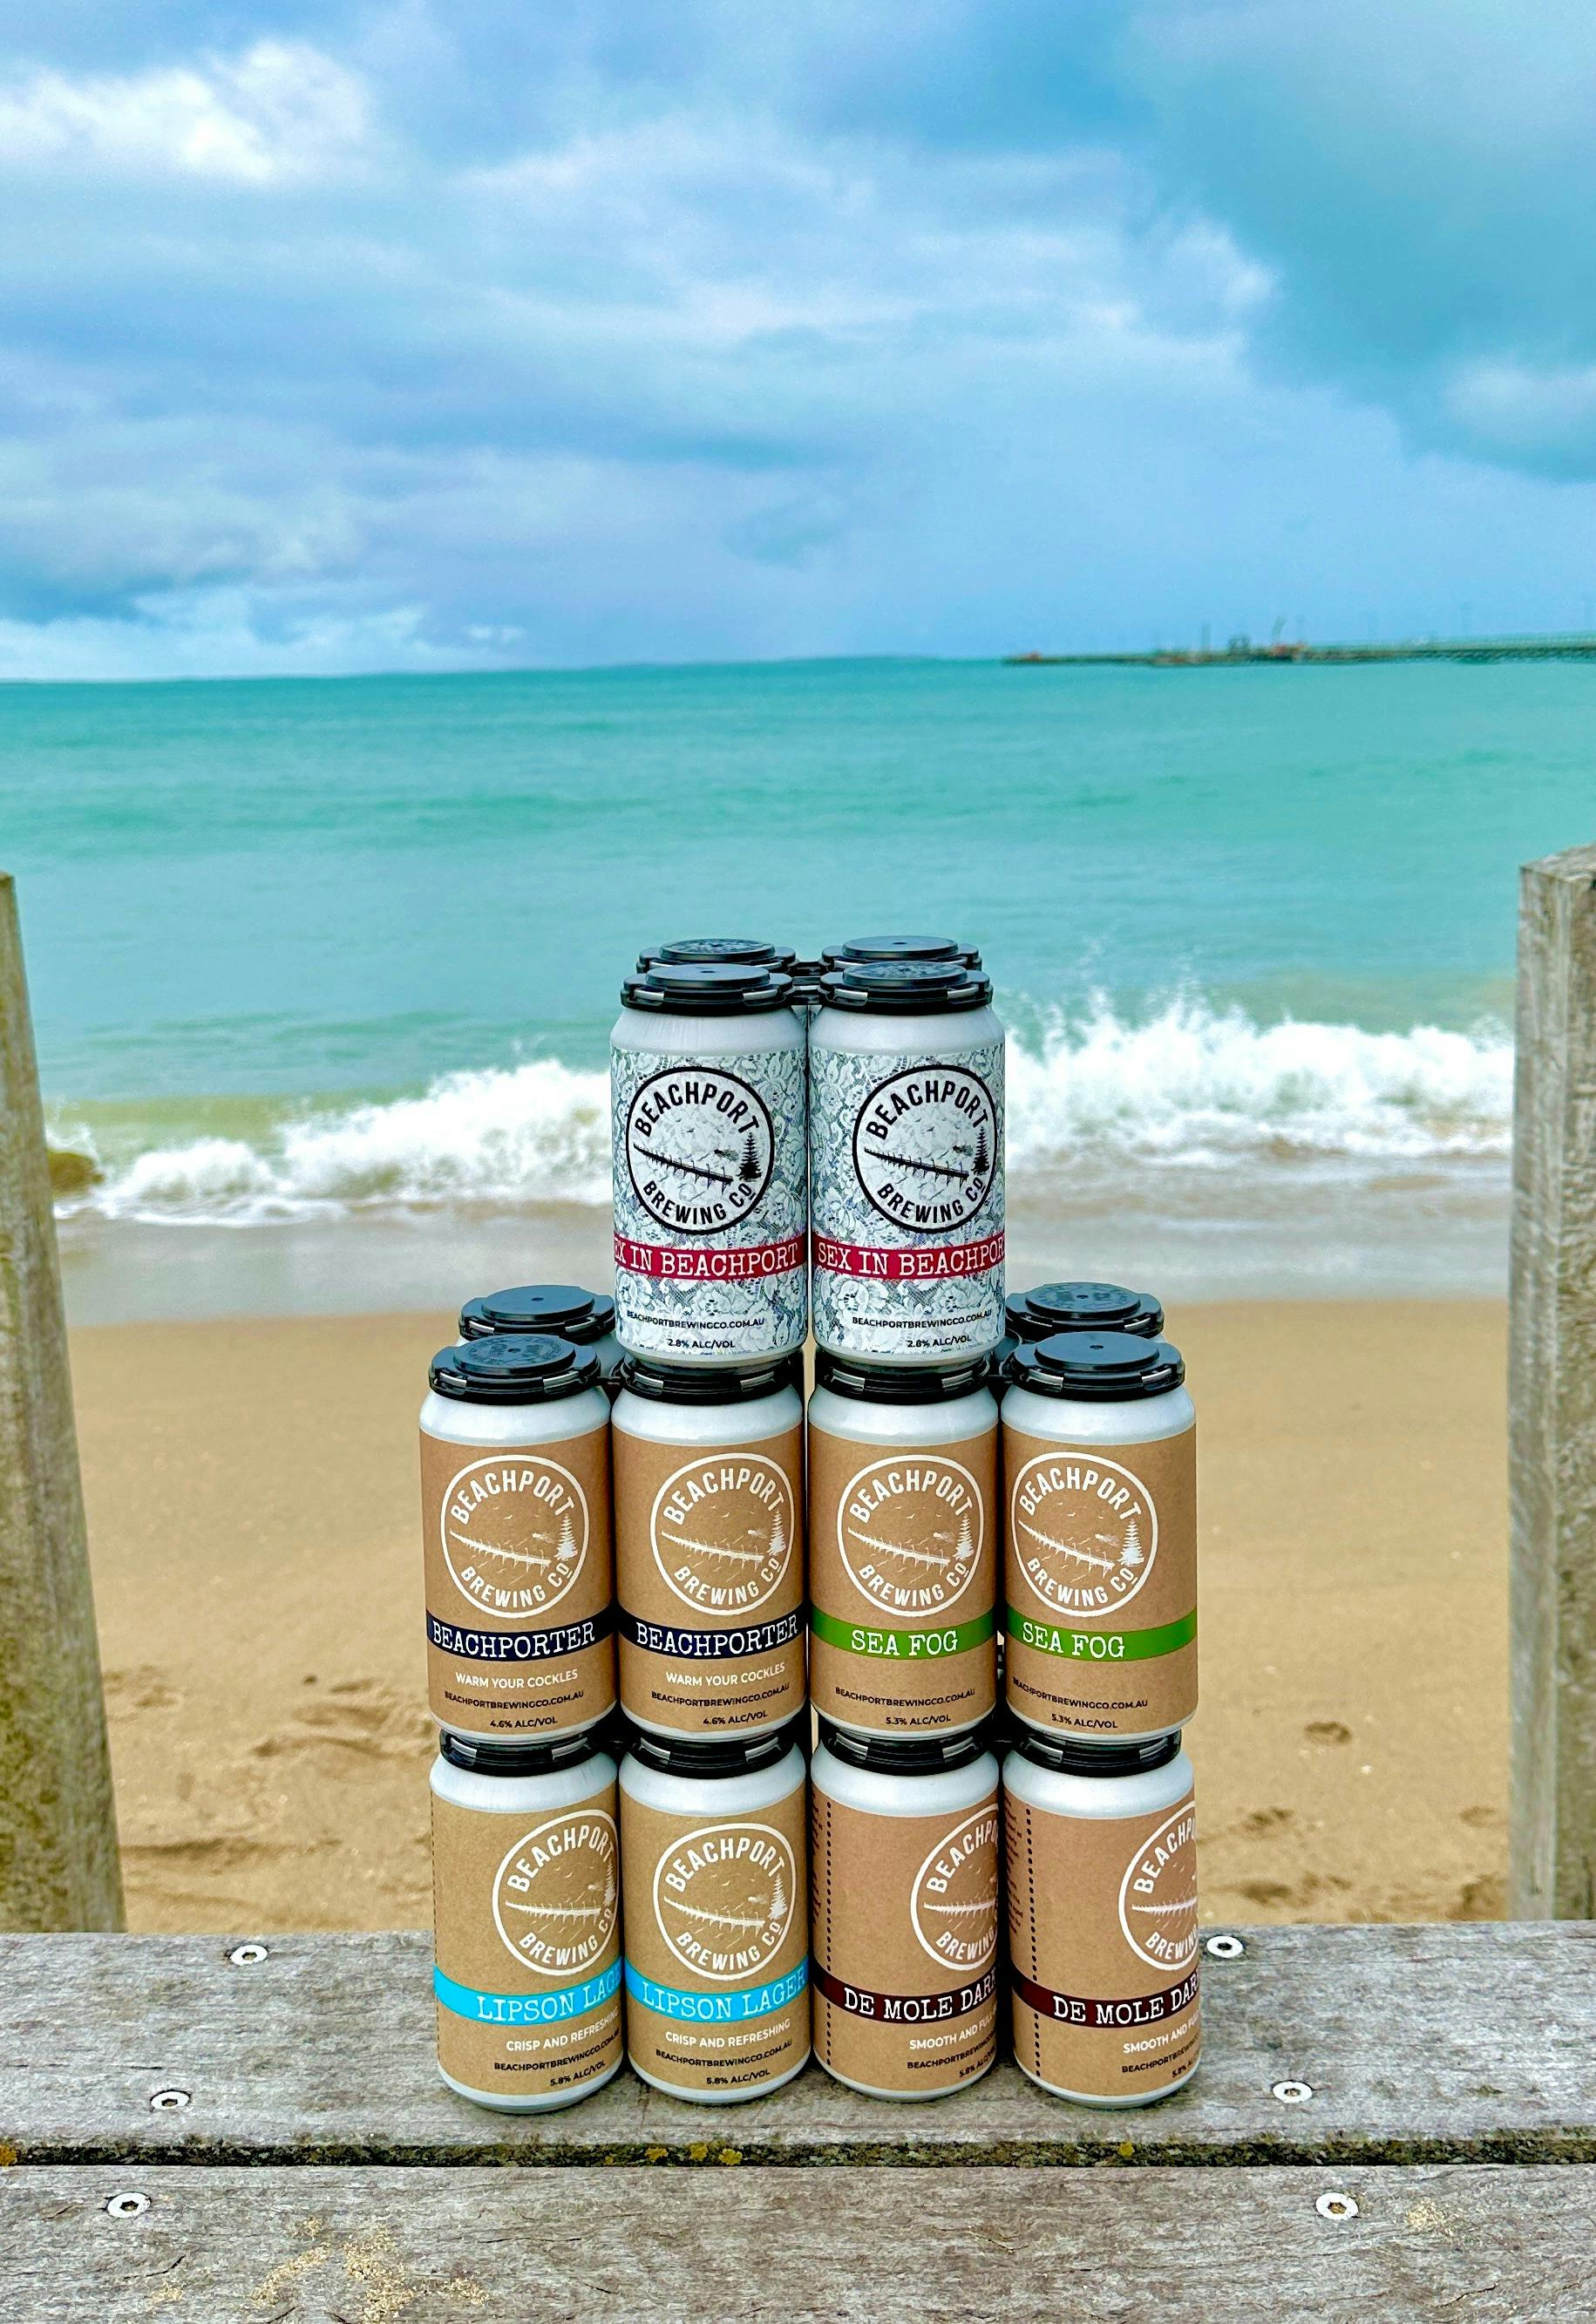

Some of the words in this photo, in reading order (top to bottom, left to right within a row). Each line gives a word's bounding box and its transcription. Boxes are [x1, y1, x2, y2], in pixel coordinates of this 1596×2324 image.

[634, 1082, 759, 1137] BEACHPORT
[865, 1079, 990, 1140] BEACHPORT
[642, 1181, 727, 1226] BREWING
[877, 1182, 965, 1225] BREWING
[614, 1238, 627, 1264] EX
[630, 1247, 652, 1271] IN
[660, 1242, 798, 1277] BEACHPORT
[818, 1242, 852, 1271] SEX
[858, 1251, 888, 1275] IN
[898, 1235, 1005, 1276] BEACHPOR
[627, 1310, 764, 1329] BEACHPORTBREWINGCO.COM.AU
[852, 1308, 992, 1329] BEACHPORTBREWINGCO.COM.AU
[668, 1338, 689, 1349] 2.8%
[691, 1340, 736, 1349] ALC/VOL
[932, 1334, 972, 1348] ALC/VOL
[450, 1469, 574, 1526] BEACHPORT
[662, 1467, 784, 1526] BEACHPORT
[849, 1469, 974, 1524] BEACHPORT
[1017, 1466, 1142, 1521] BEACHPORT
[459, 1566, 547, 1607] BREWING
[673, 1566, 759, 1606] BREWING
[859, 1564, 945, 1607] BREWING
[1026, 1558, 1109, 1606] BREWING
[431, 1619, 595, 1658] BEACHPORTER
[635, 1613, 798, 1656] BEACHPORTER
[851, 1629, 900, 1655] SEA
[907, 1629, 959, 1655] FOG
[1022, 1622, 1065, 1655] SEA
[1070, 1634, 1126, 1658] FOG
[455, 1671, 489, 1689] WARM
[491, 1673, 525, 1689] YOUR
[526, 1668, 579, 1688] COCKLES
[665, 1671, 702, 1688] WARM
[703, 1671, 737, 1687] YOUR
[738, 1662, 785, 1685] COCKLES
[444, 1689, 584, 1710] BEACHPORTBREWINGCO.COM.AU
[651, 1682, 790, 1708] BEACHPORTBREWINGCO.COM.AU
[835, 1687, 975, 1708] BEACHPORTBREWINGCO.COM.AU
[514, 1715, 558, 1729] ALC/VOL
[727, 1710, 768, 1725] ALC/VOL
[909, 1714, 951, 1726] ALC/VOL
[1050, 1713, 1072, 1725] 5.3%
[1073, 1716, 1118, 1729] ALC/VOL
[506, 1825, 615, 1892] BEACHPORT
[665, 1838, 785, 1892] BEACHPORT
[926, 1818, 997, 1893] BEACHPO
[1133, 1818, 1196, 1894] BEACHP
[519, 1932, 598, 1965] BREWING
[676, 1931, 761, 1971] BREWING
[936, 1925, 995, 1960] BREWING
[477, 1992, 576, 2022] LIPSON
[583, 1965, 621, 2008] LAGE
[642, 1981, 732, 2020] LIPSON
[742, 1966, 805, 2016] LAGER
[844, 1987, 874, 2015] DE
[884, 1996, 953, 2021] MOLE
[1053, 1995, 1086, 2022] DE
[1096, 1997, 1165, 2024] MOLE
[1171, 1970, 1199, 2011] DAR
[506, 2041, 540, 2051] CRISP
[543, 2035, 568, 2049] AND
[571, 2007, 619, 2042] REFRESHING
[665, 2031, 696, 2046] CRISP
[699, 2037, 725, 2048] AND
[728, 2018, 791, 2048] REFRESHING
[909, 2034, 957, 2049] SMOOTH
[959, 2024, 978, 2042] AND
[1123, 2035, 1169, 2054] SMOOTH
[1171, 2023, 1187, 2041] AND
[550, 2076, 572, 2086] 5.8%
[573, 2060, 606, 2080] ALC/VOL
[730, 2069, 771, 2084] ALC/VOL
